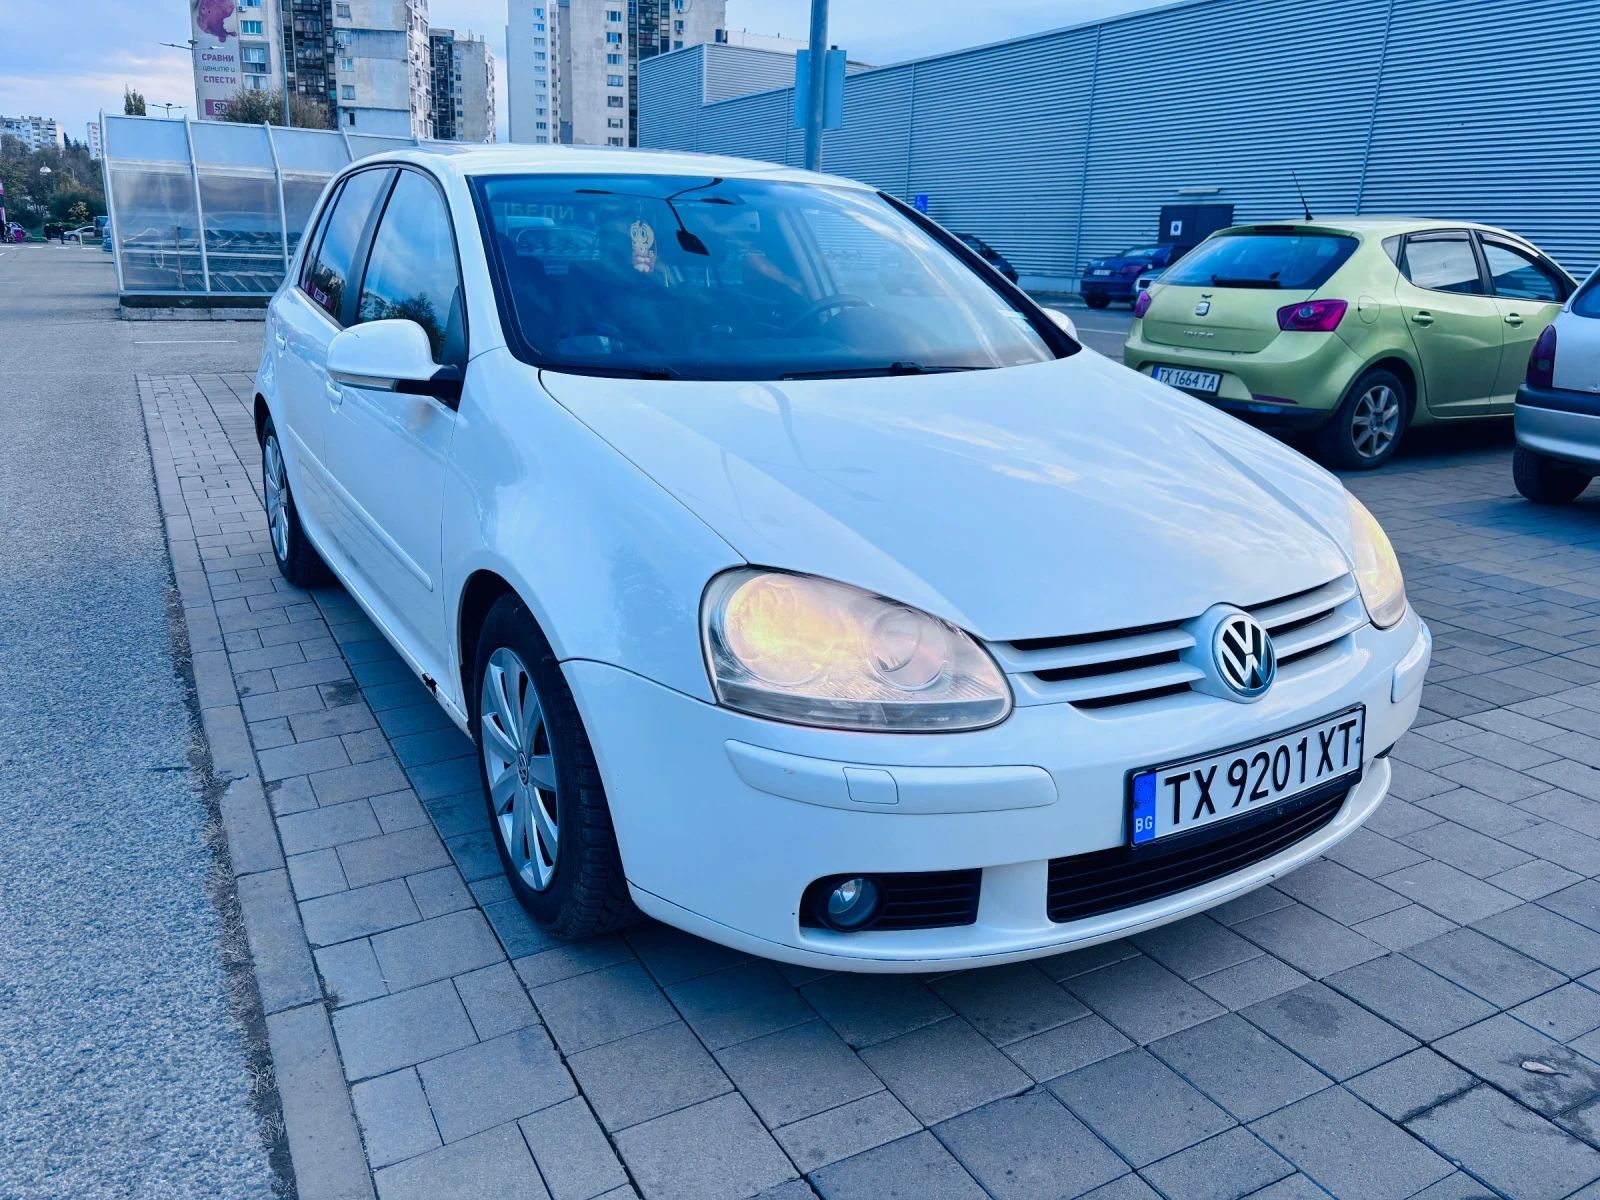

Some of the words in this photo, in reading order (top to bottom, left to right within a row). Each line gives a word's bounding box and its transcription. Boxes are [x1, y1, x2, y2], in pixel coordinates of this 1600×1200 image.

[201, 53, 234, 63] СРАВНИ
[203, 75, 236, 85] СПЕСТИ
[1160, 368, 1175, 385] TX
[1175, 371, 1200, 389] 1664
[1202, 374, 1216, 390] TA
[1215, 613, 1276, 696] VW
[1164, 765, 1218, 825] TX
[1227, 736, 1308, 808] 9201
[1316, 718, 1357, 777] XT
[1135, 815, 1153, 833] BG
